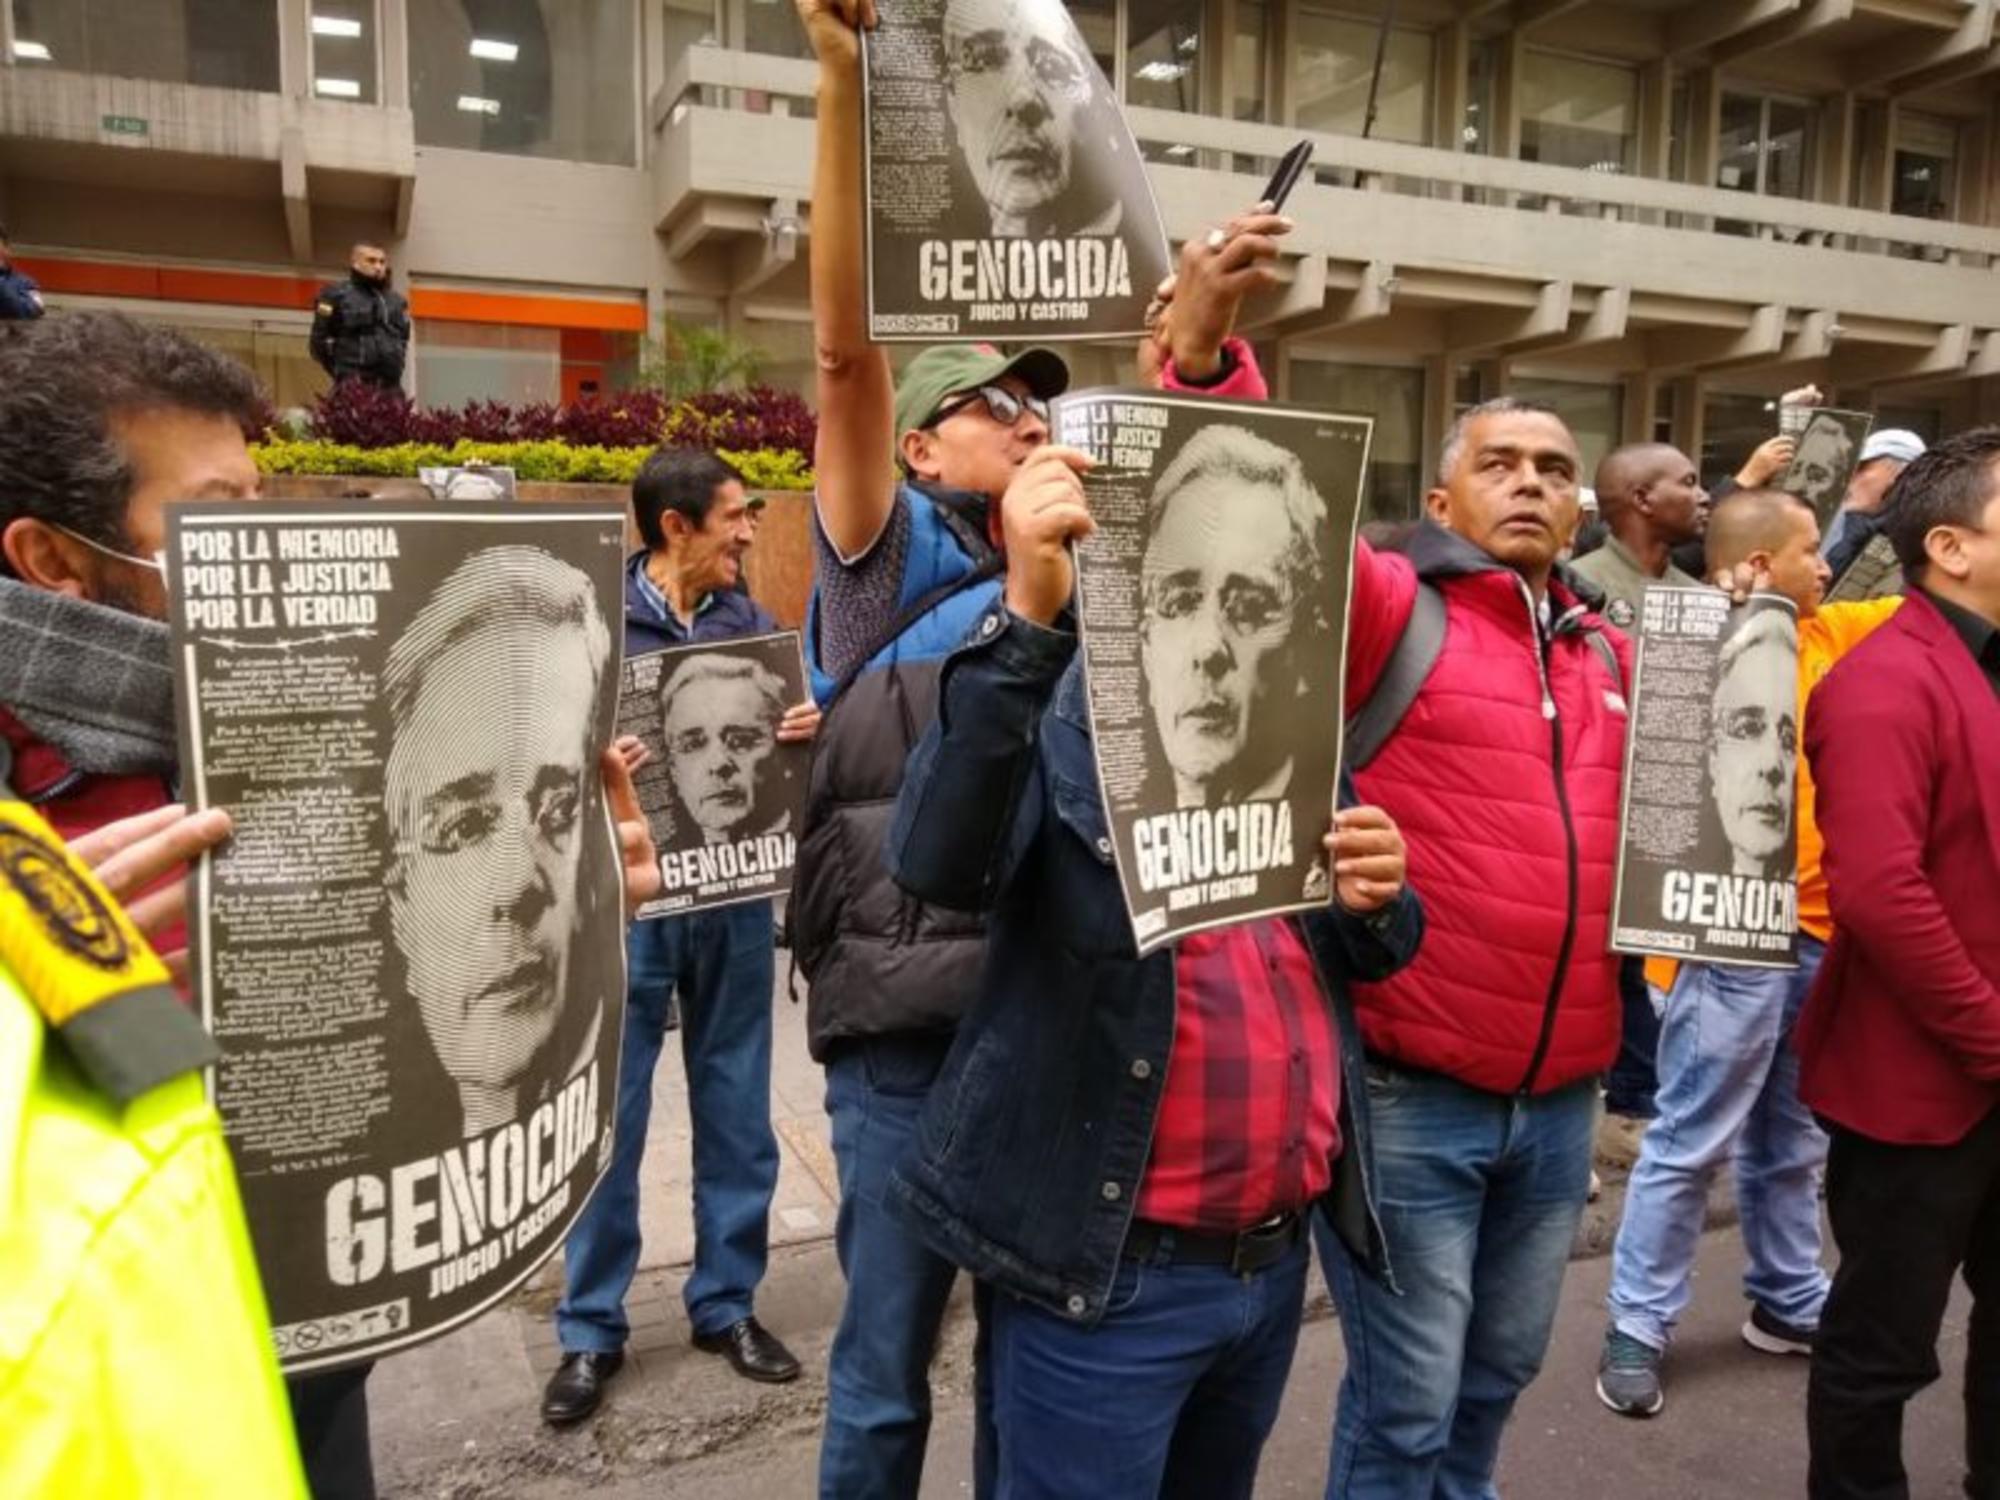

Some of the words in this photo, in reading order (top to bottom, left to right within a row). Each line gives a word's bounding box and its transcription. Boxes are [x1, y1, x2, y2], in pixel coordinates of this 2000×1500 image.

[919, 238, 1132, 300] GENOCIDA
[970, 303, 1016, 321] JUICIO
[1017, 303, 1029, 320] Y
[1030, 302, 1088, 320] CASTIGO
[182, 531, 233, 561] POR
[238, 529, 271, 560] LA
[278, 527, 399, 560] MEMORIA
[184, 564, 236, 597] POR
[241, 563, 273, 594] LA
[282, 561, 392, 593] JUSTICIA
[186, 598, 238, 630] POR
[243, 596, 275, 628] LA
[283, 594, 377, 627] VERDAD
[1132, 800, 1292, 893] GENOCIDA
[326, 1059, 599, 1286] GENOCIDA
[428, 1238, 501, 1299] JUICIO
[502, 1227, 515, 1259] Y
